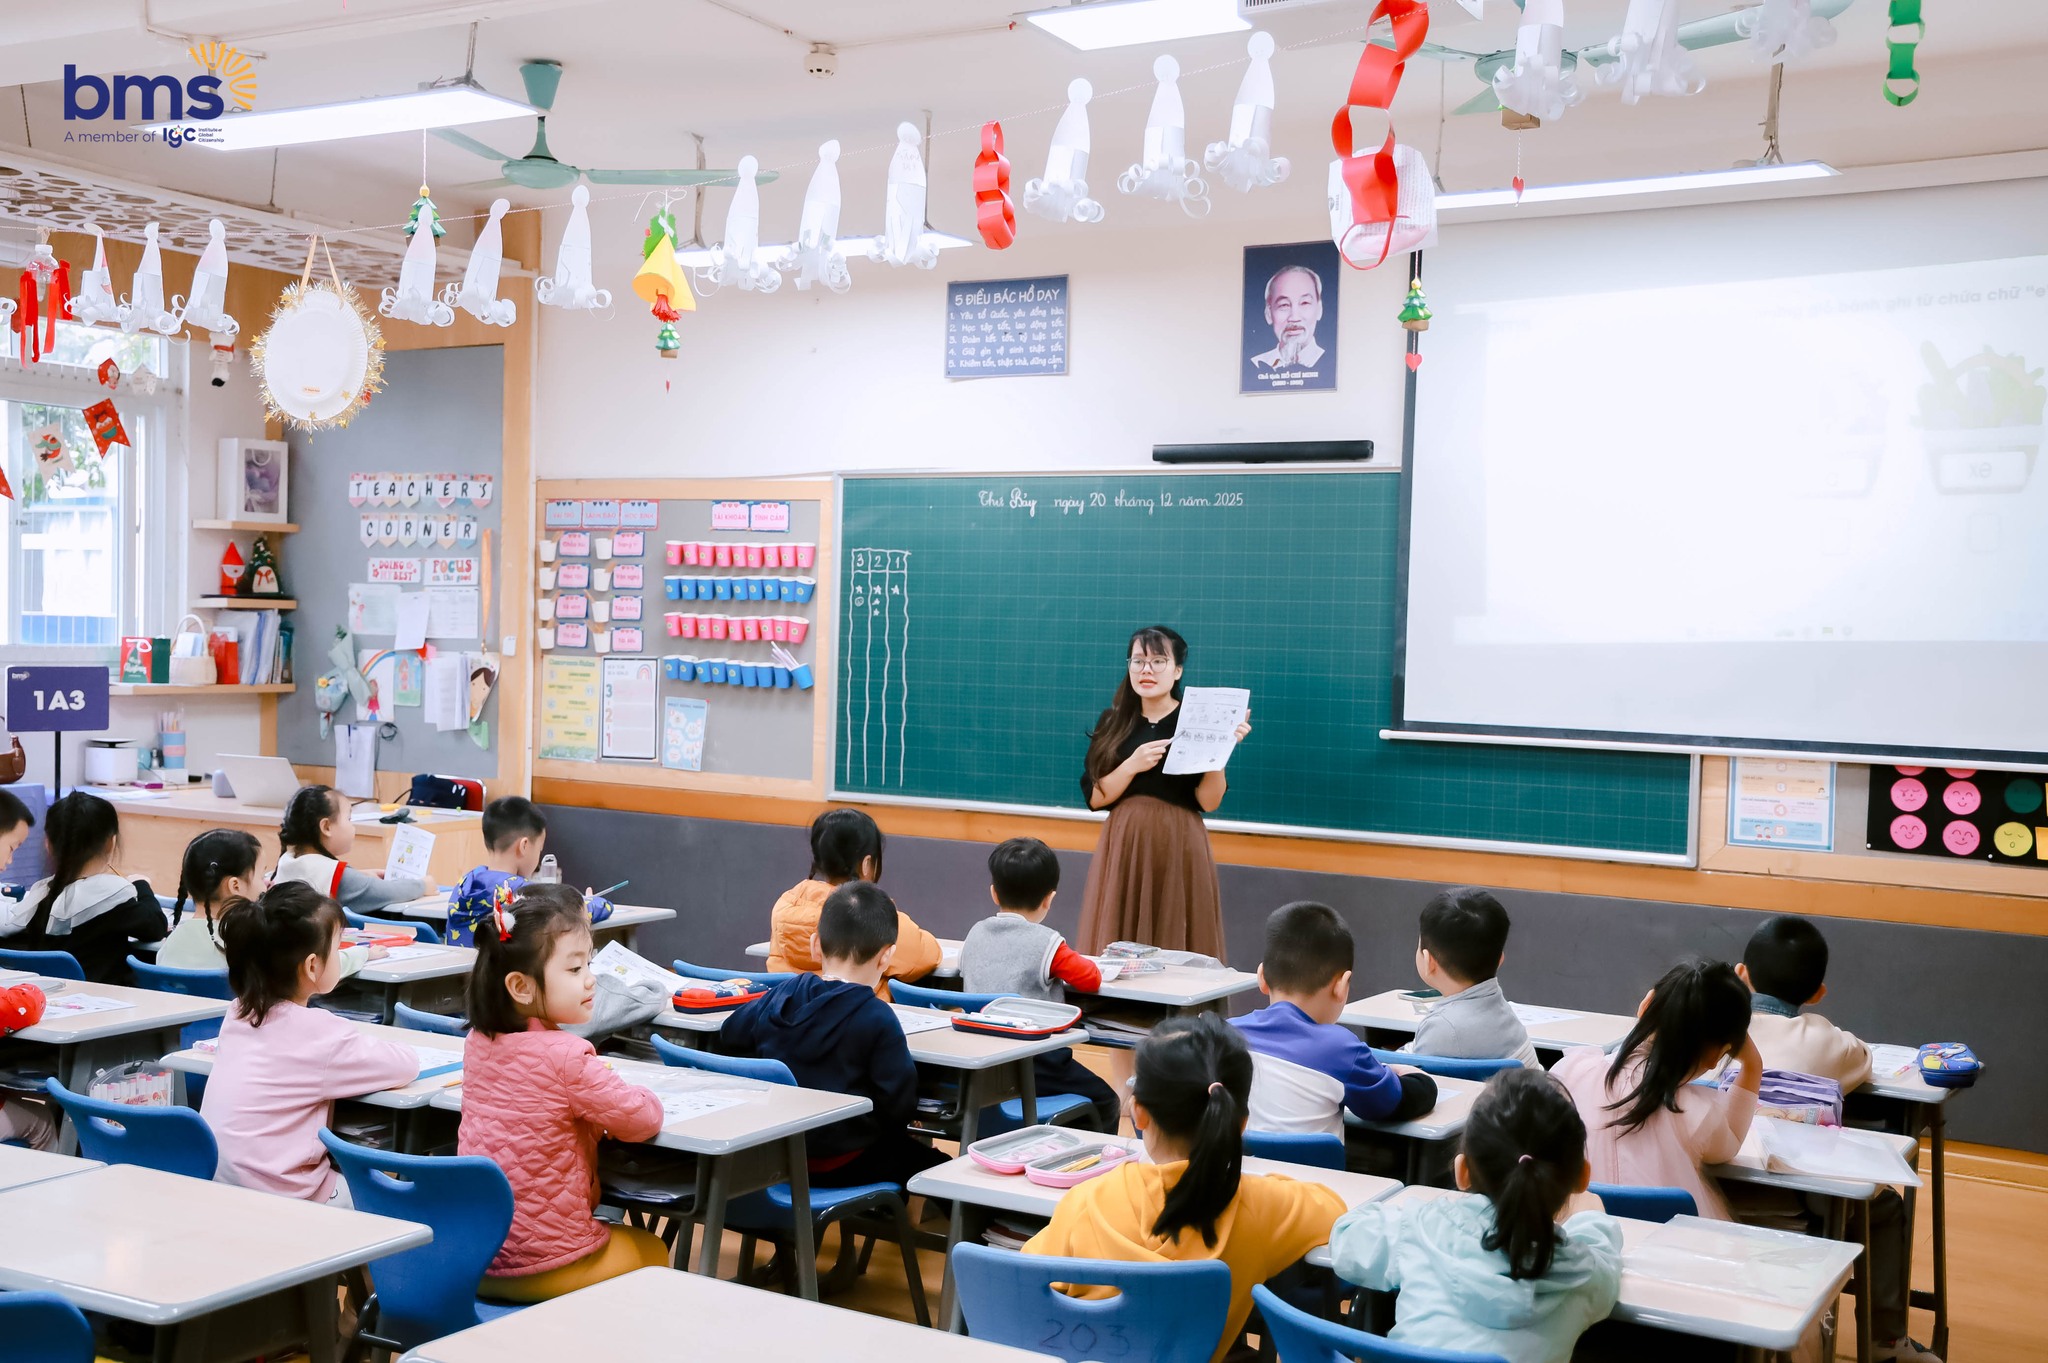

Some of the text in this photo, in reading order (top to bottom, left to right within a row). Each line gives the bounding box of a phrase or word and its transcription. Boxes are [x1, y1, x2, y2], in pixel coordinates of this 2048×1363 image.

[955, 284, 1060, 306] 5 ĐIỀU BÁC HỒ DẠY
[1938, 290, 1982, 306] chứa
[1987, 286, 2020, 302] chữ
[355, 481, 488, 498] TEACHER'S
[1054, 496, 1085, 515] ngày
[1090, 492, 1106, 507] 20
[1114, 489, 1154, 515] tháng
[1160, 492, 1173, 507] 12
[1178, 496, 1211, 507] năm
[1213, 492, 1244, 507] 2025
[366, 521, 471, 538] CORNER
[379, 560, 404, 570] DOING
[433, 559, 473, 573] FOCUS
[856, 552, 865, 567] 3
[874, 555, 883, 567] 2
[895, 556, 900, 569] 1
[393, 571, 413, 581] BEST
[605, 684, 613, 698] 3
[33, 690, 86, 711] 1A3
[605, 708, 613, 723] 2
[605, 732, 612, 748] 1
[1039, 1318, 1131, 1358] 203
